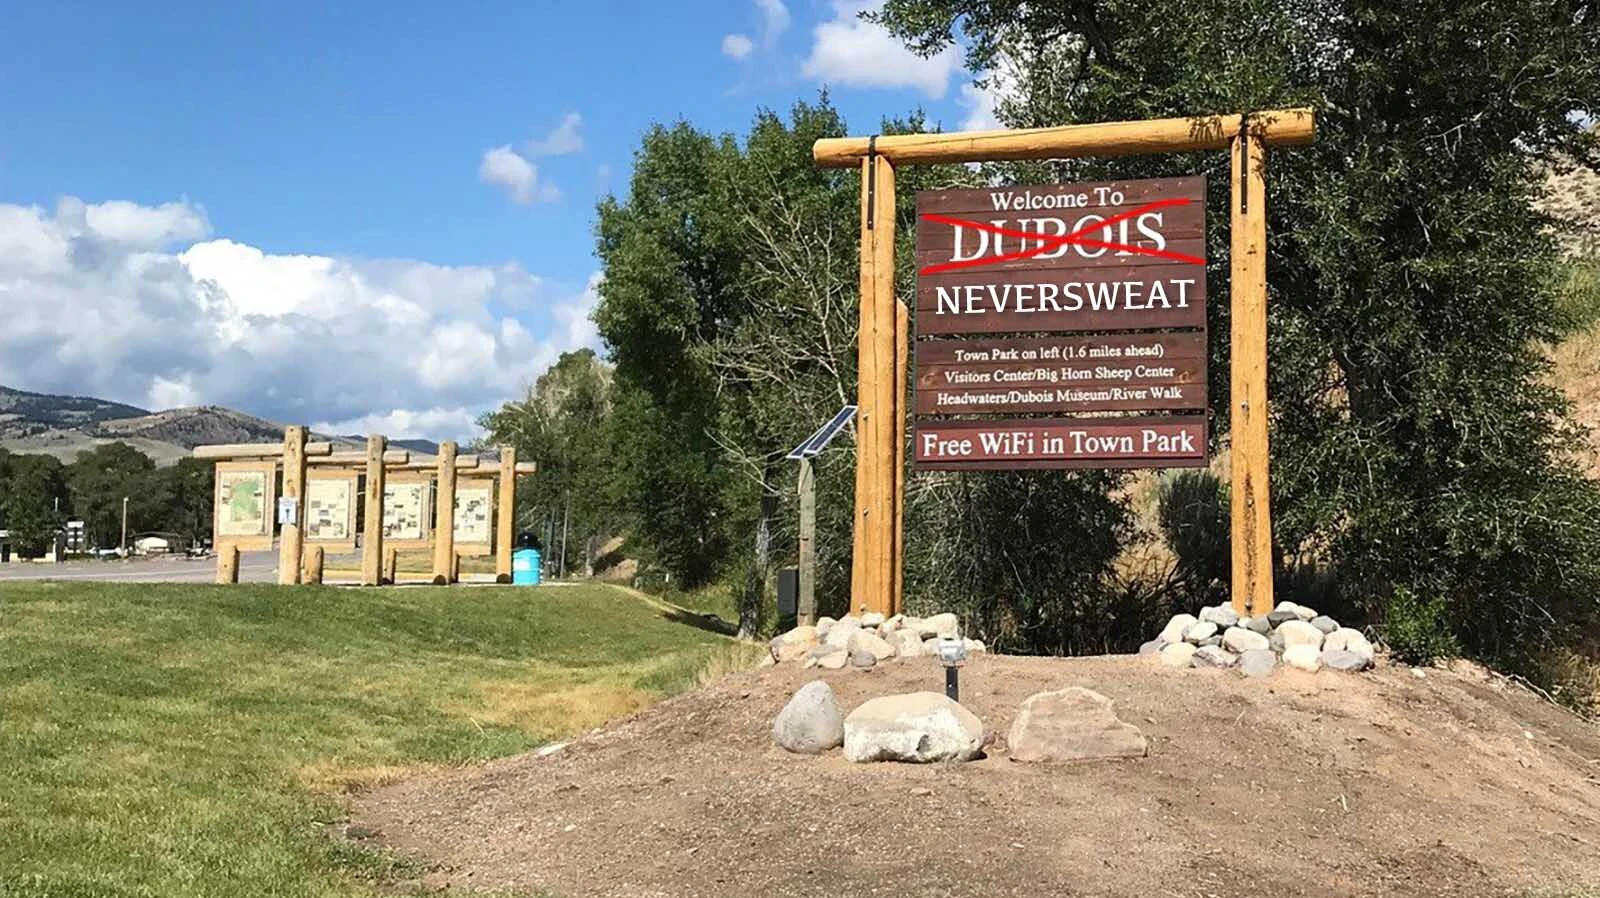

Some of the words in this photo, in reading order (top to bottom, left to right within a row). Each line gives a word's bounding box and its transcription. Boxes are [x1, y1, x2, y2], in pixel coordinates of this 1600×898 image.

[990, 190, 1089, 211] Welcome
[1094, 187, 1125, 207] To
[949, 212, 1167, 262] DUBOIS
[955, 350, 990, 362] Town
[991, 349, 1019, 360] Park
[1022, 350, 1038, 360] on
[1040, 346, 1060, 359] left
[1063, 345, 1086, 360] (1.6
[1089, 345, 1121, 358] miles
[1124, 344, 1164, 358] ahead)
[945, 371, 991, 384] Visitors
[994, 369, 1058, 384] Center/Big
[1062, 368, 1092, 380] Horn
[1095, 367, 1132, 381] Sheep
[1135, 365, 1176, 378] Center
[937, 390, 1054, 405] Headwaters/Dubois
[1056, 387, 1147, 402] Museum/River
[1150, 386, 1183, 400] Walk
[922, 433, 972, 457] Free
[978, 431, 1034, 455] WiFi
[1042, 432, 1064, 454] in
[1069, 430, 1134, 453] Town
[1141, 429, 1195, 453] Park
